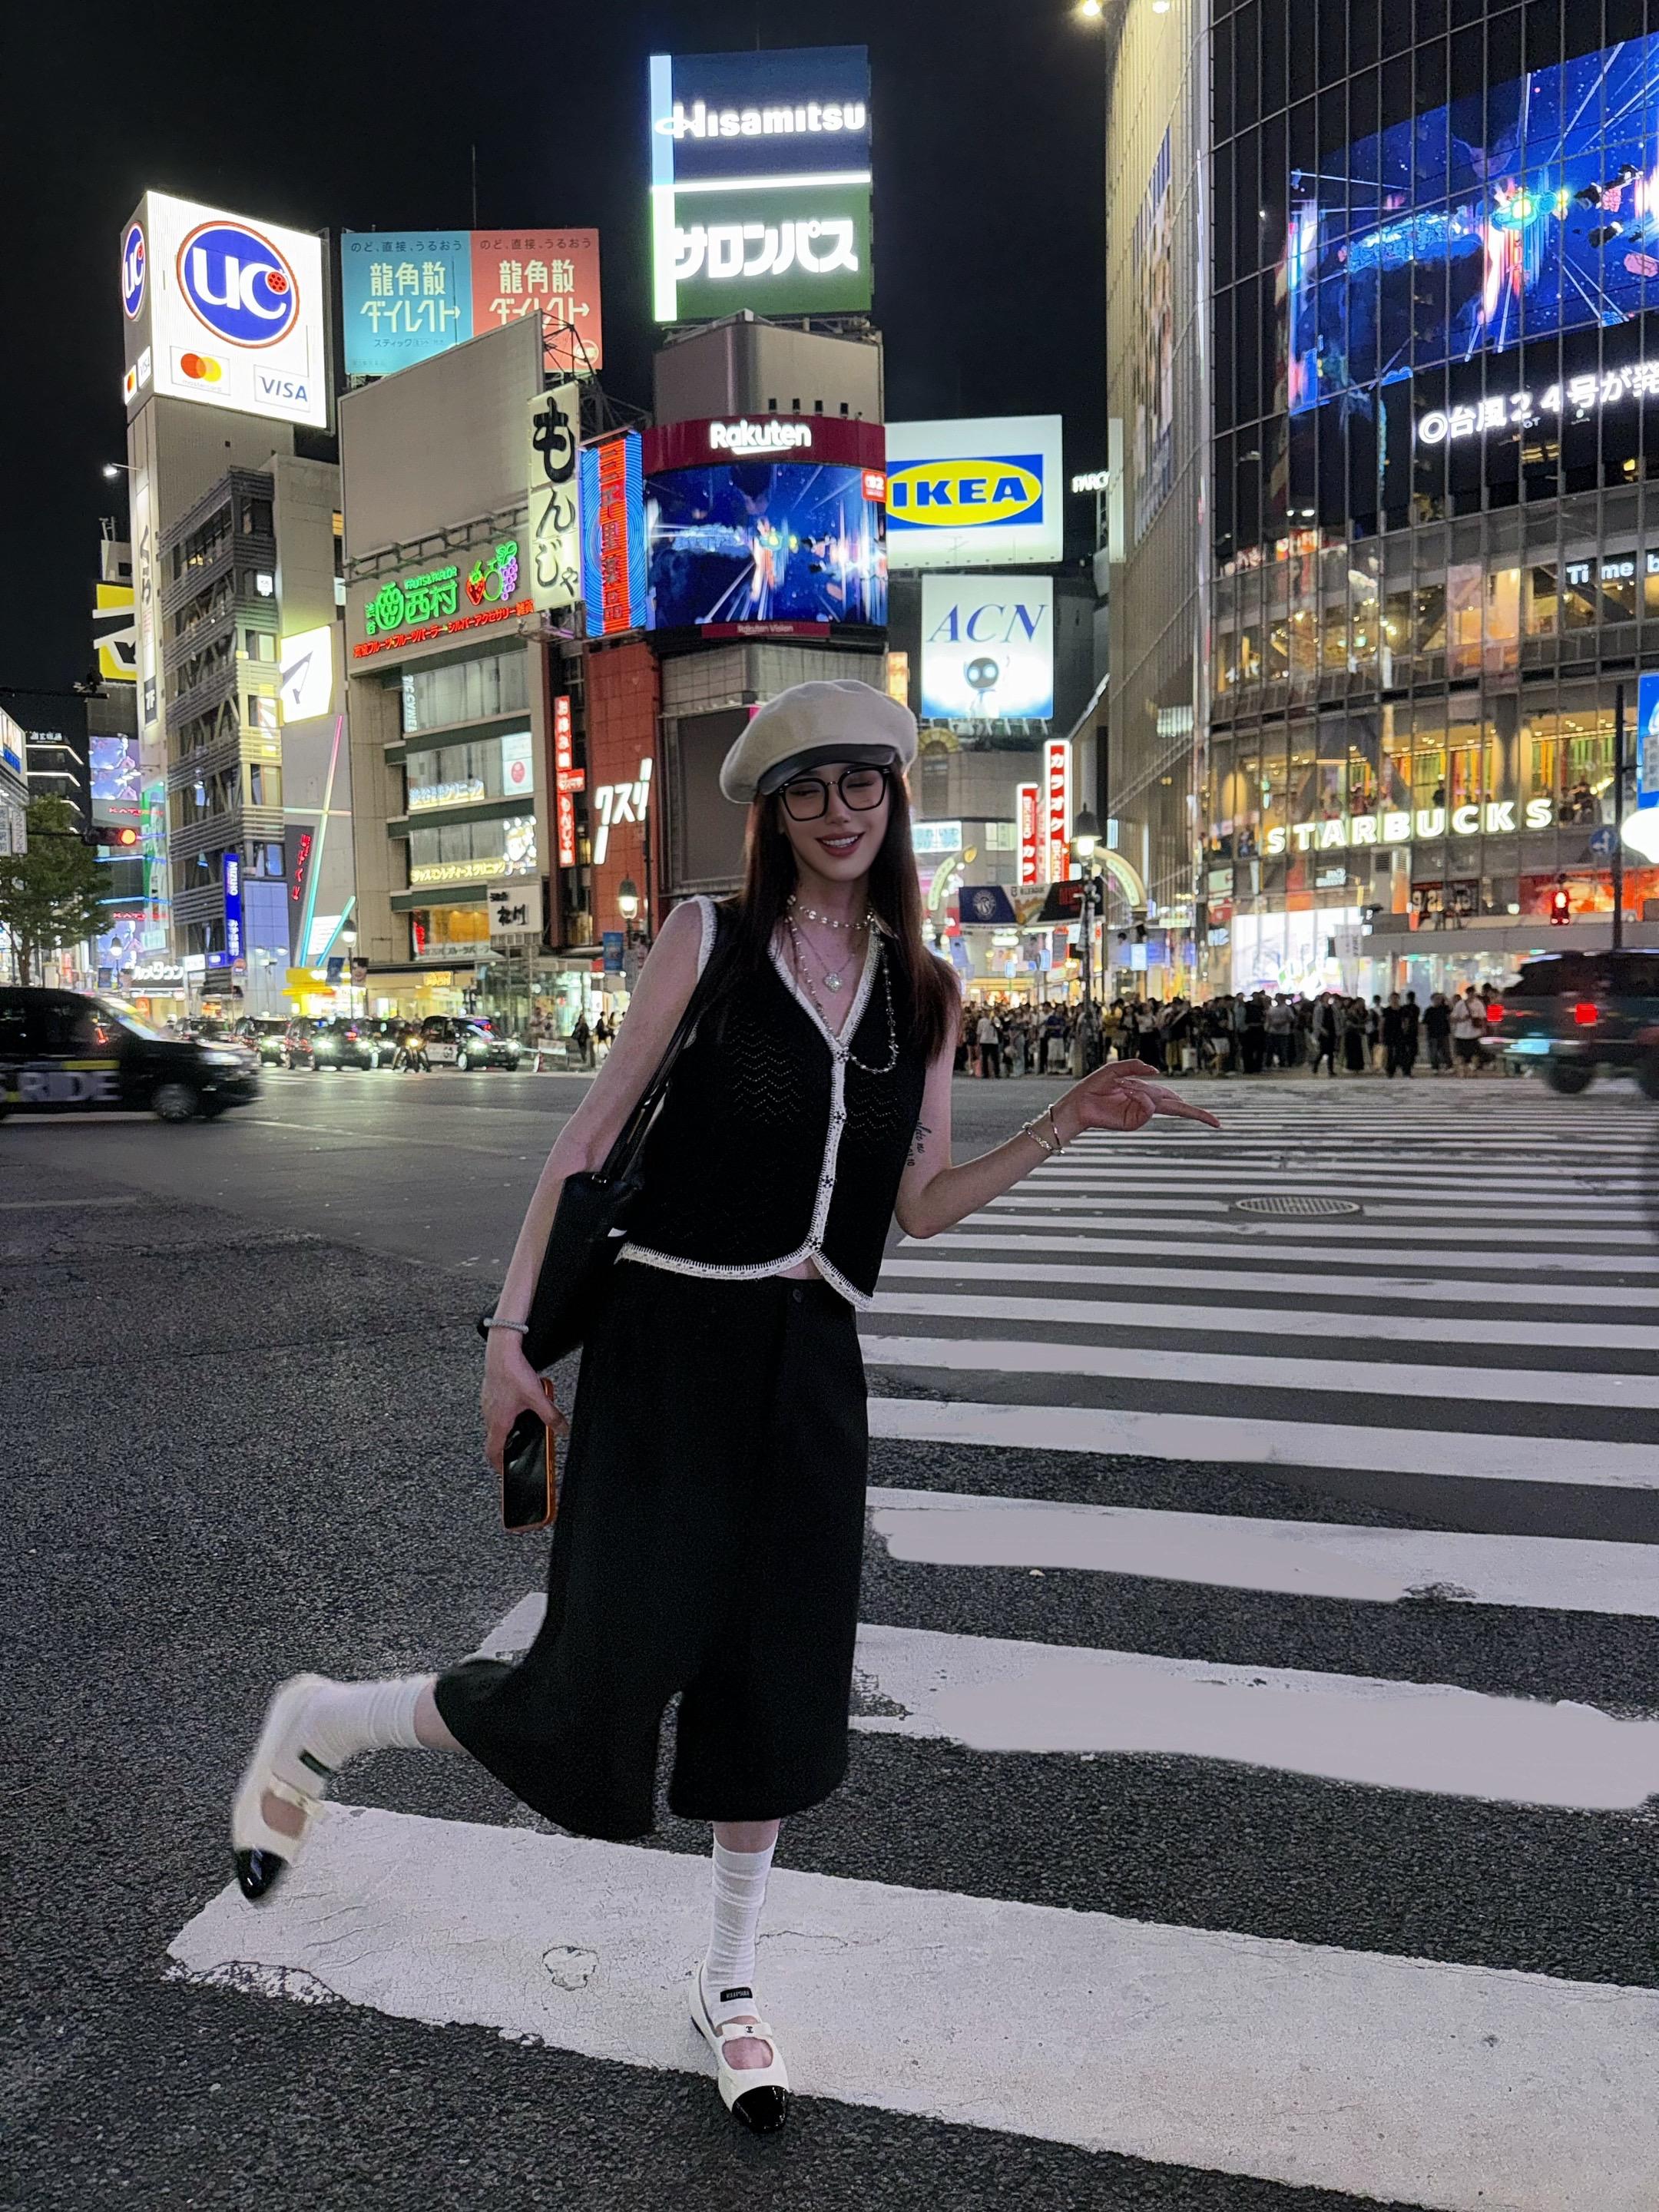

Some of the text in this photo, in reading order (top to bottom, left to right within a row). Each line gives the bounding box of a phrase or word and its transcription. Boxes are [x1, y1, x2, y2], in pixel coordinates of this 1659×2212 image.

[654, 101, 866, 139] Hisamitsu
[665, 220, 859, 280] サロンパス
[193, 245, 287, 320] UC
[369, 261, 446, 296] 龍角散
[498, 259, 575, 294] 龍角散
[259, 375, 309, 402] VISA
[710, 419, 812, 455] Rakuten
[533, 396, 579, 598] もんじゃ
[892, 477, 1029, 508] IKEA
[404, 579, 459, 625] 西村
[926, 604, 1049, 643] ACN
[1267, 798, 1554, 854] STARBUCKS
